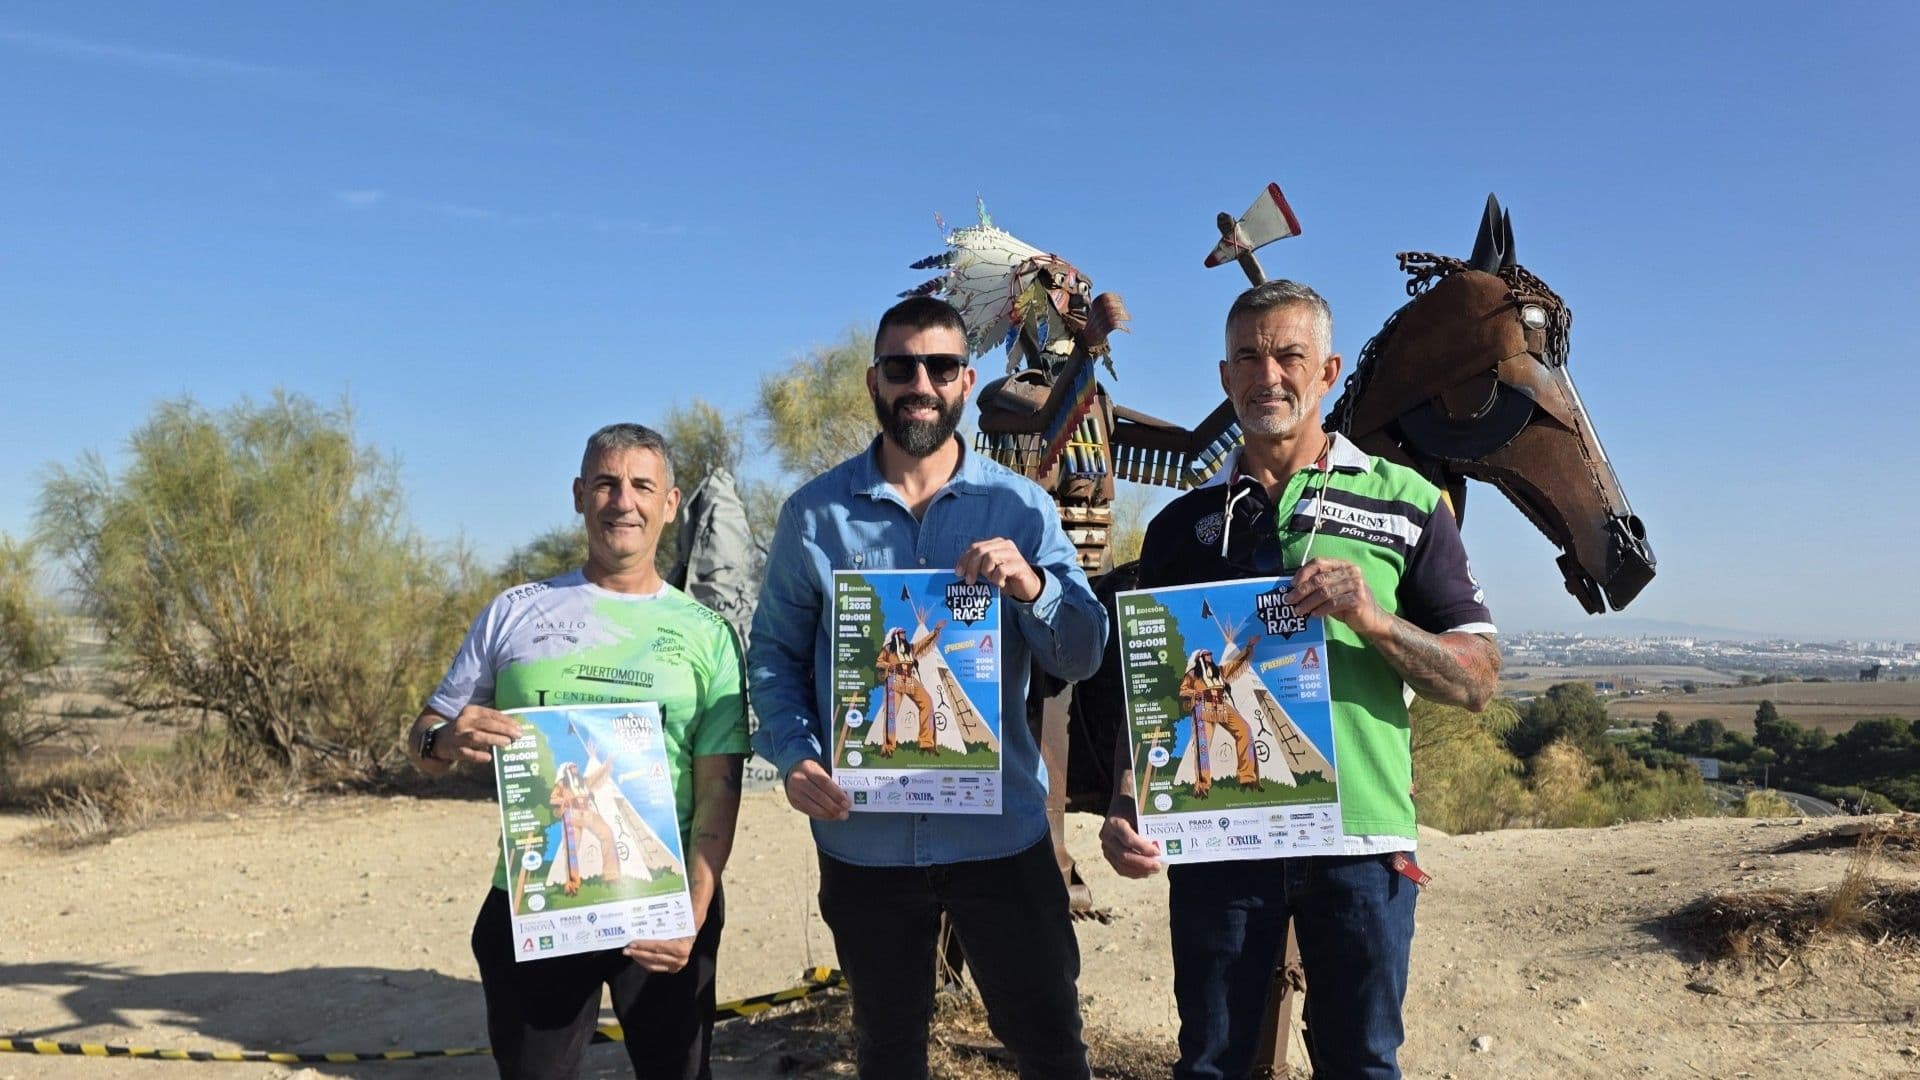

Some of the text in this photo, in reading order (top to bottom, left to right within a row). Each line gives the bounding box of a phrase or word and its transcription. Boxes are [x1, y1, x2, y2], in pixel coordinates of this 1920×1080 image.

[1321, 505, 1388, 528] KILARNY
[947, 585, 991, 598] INNOVA
[849, 602, 872, 610] 2026
[953, 597, 987, 609] FLOW
[1257, 593, 1290, 609] INNO
[839, 613, 871, 621] 09:00H
[953, 608, 985, 620] RACE
[536, 621, 586, 630] MARIO
[1127, 619, 1139, 636] 1
[1138, 624, 1166, 636] 2026
[1268, 617, 1306, 635] RACE
[1128, 637, 1167, 649] 09:00H
[578, 663, 654, 684] PUERTOMOTOR
[554, 690, 604, 703] CENTRO
[503, 751, 538, 762] 09:00H
[1145, 821, 1185, 835] INNOVA
